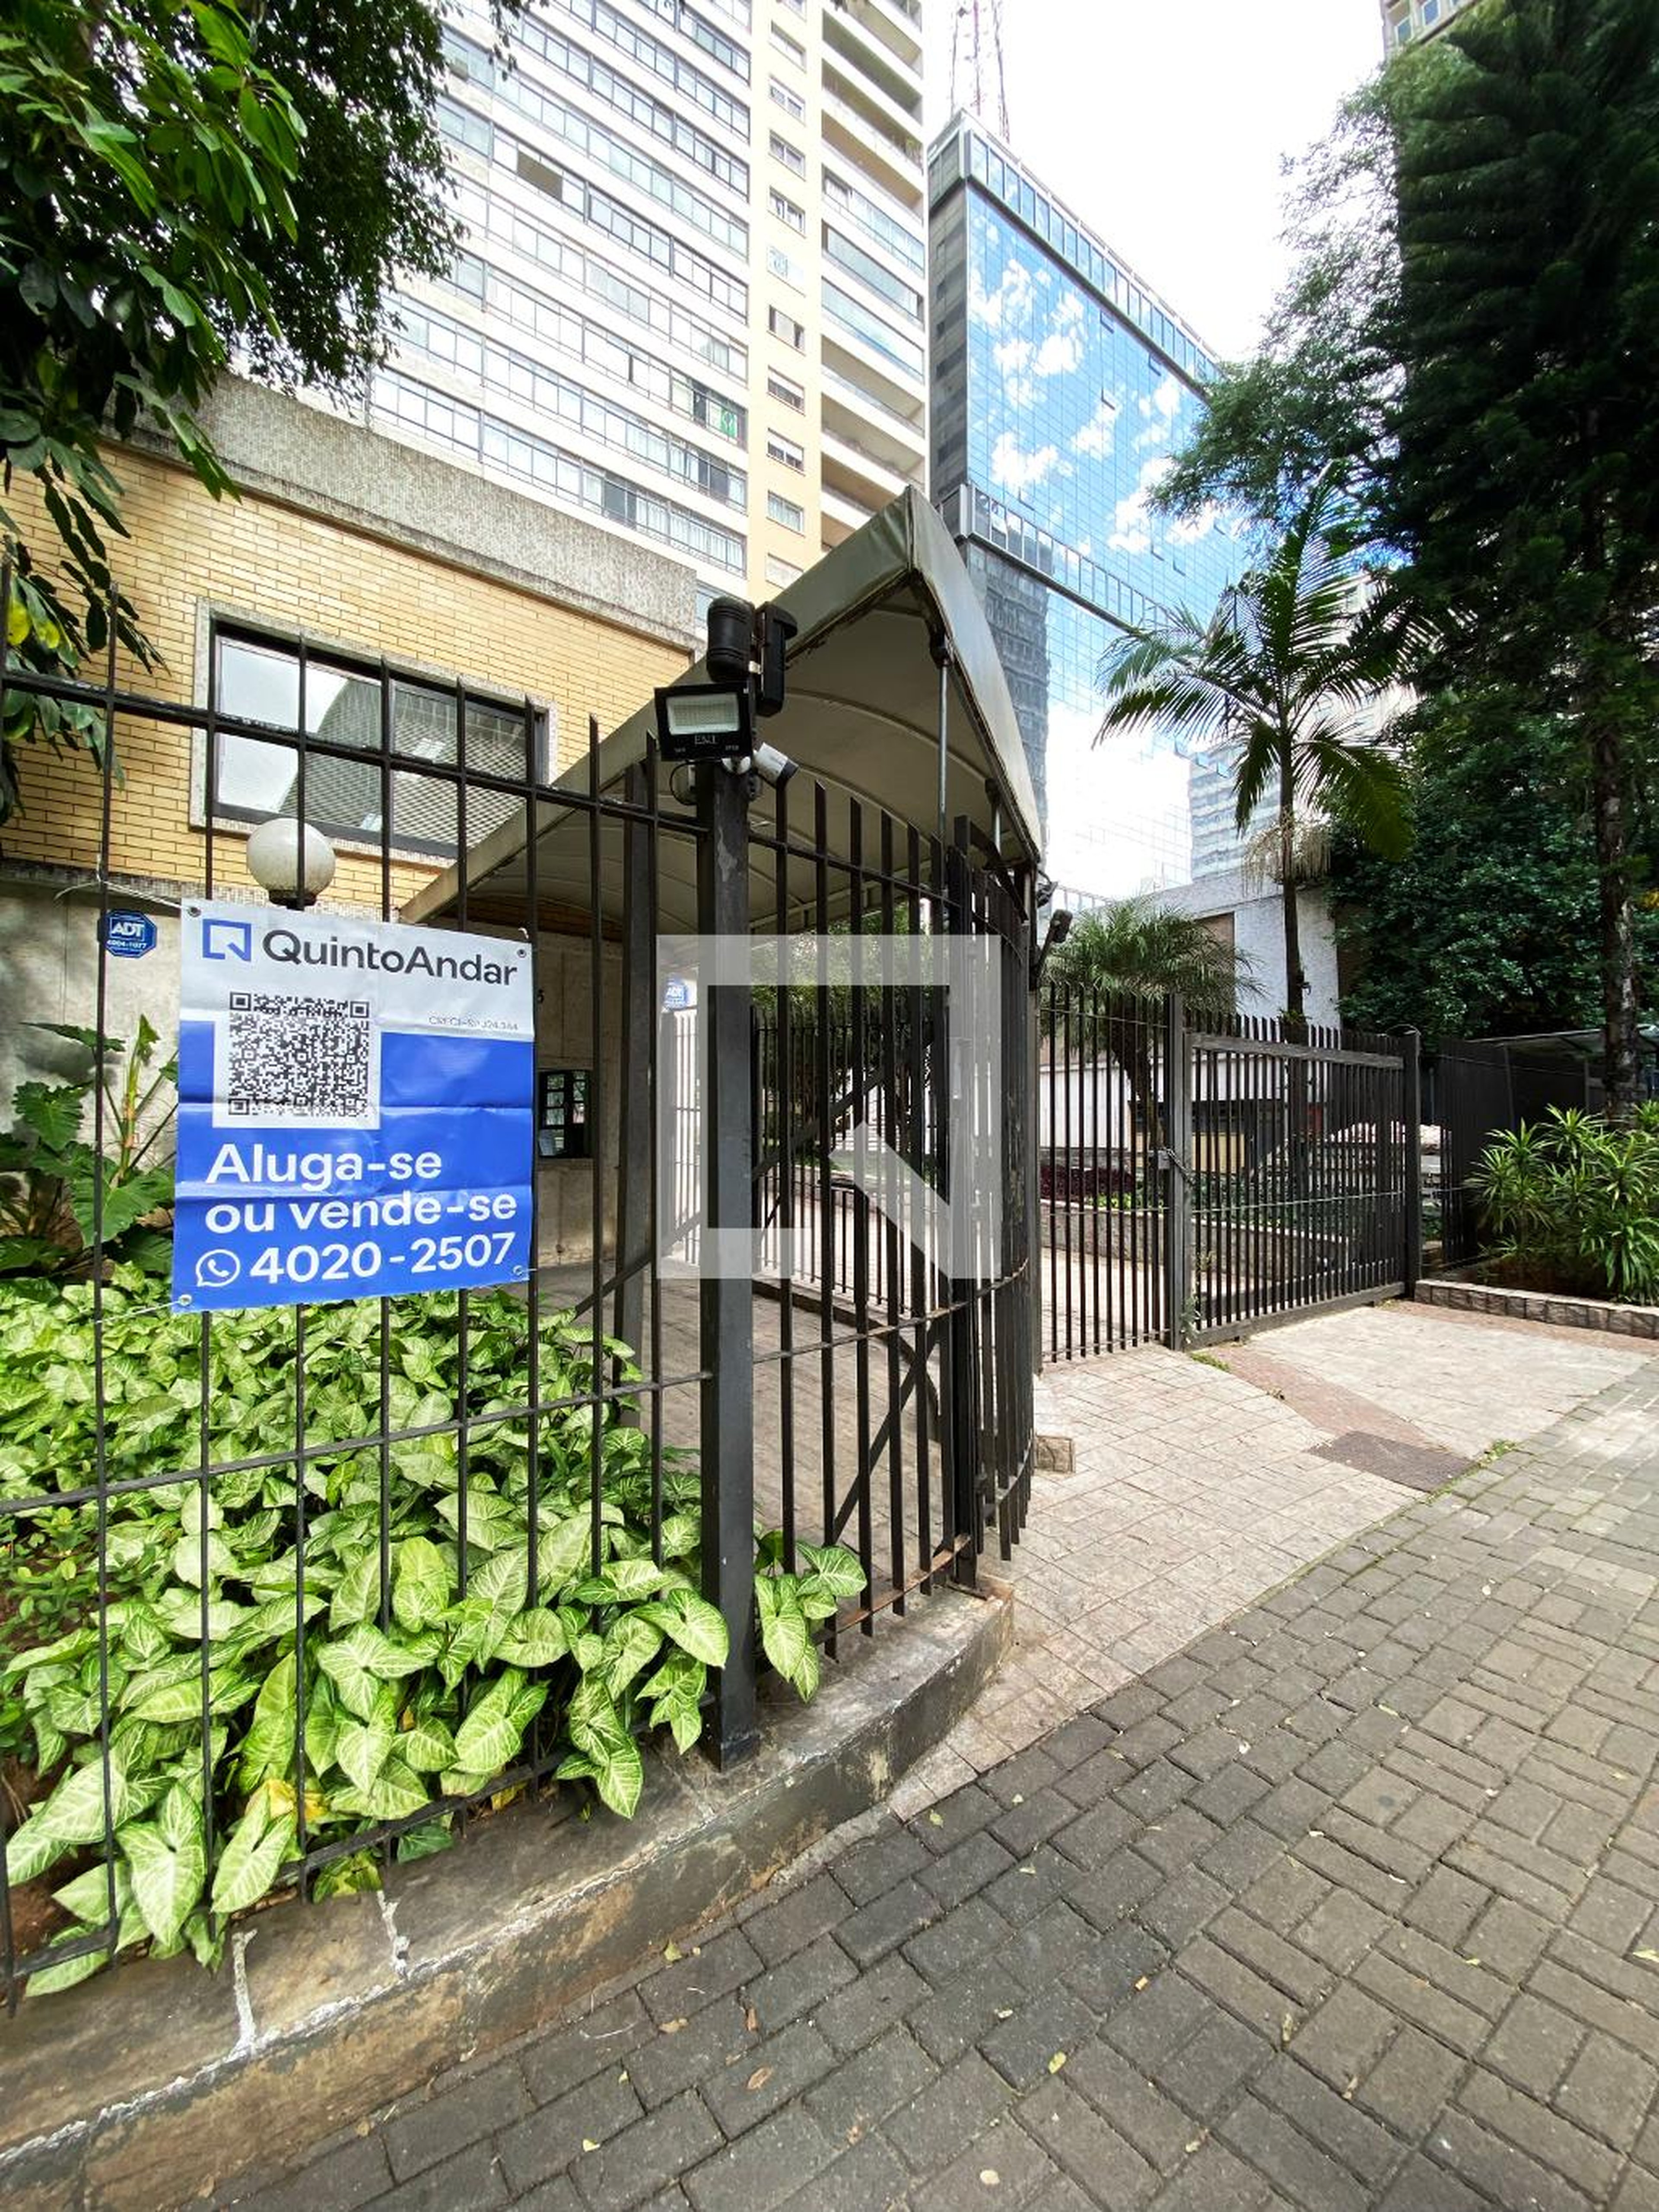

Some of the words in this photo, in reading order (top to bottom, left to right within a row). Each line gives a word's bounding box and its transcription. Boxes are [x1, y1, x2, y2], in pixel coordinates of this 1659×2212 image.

[111, 922, 144, 937] ADT
[262, 929, 517, 986] QuintoAndar
[206, 1143, 441, 1190] Aluga-se
[206, 1203, 274, 1233] ou
[289, 1190, 517, 1230] vende-se
